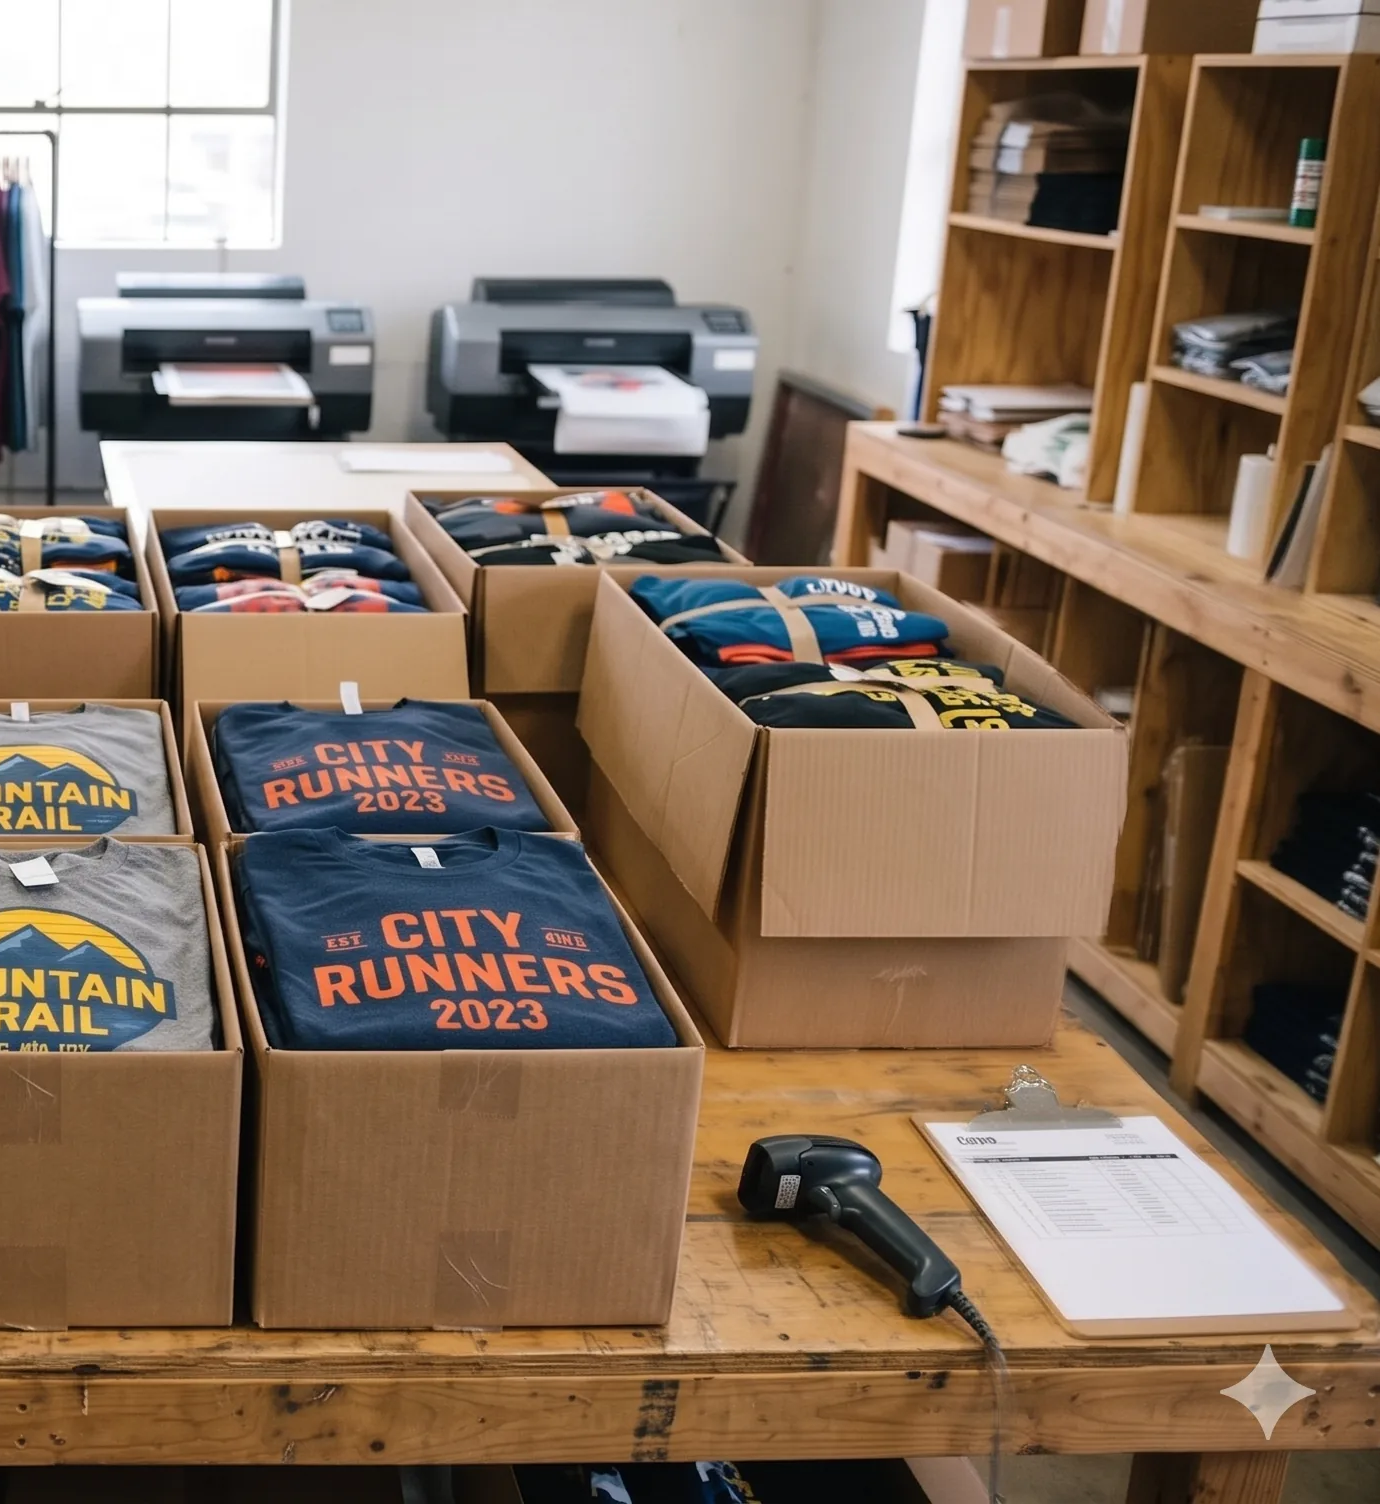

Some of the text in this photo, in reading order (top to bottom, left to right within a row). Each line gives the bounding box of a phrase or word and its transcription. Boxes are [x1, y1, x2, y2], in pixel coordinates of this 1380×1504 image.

[313, 739, 425, 767] CITY
[262, 764, 517, 810] RUNNERS
[353, 789, 448, 814] 2023
[326, 934, 362, 949] EST
[380, 909, 523, 950] CITY
[313, 952, 639, 1007] RUNNERS
[430, 998, 549, 1031] 2023
